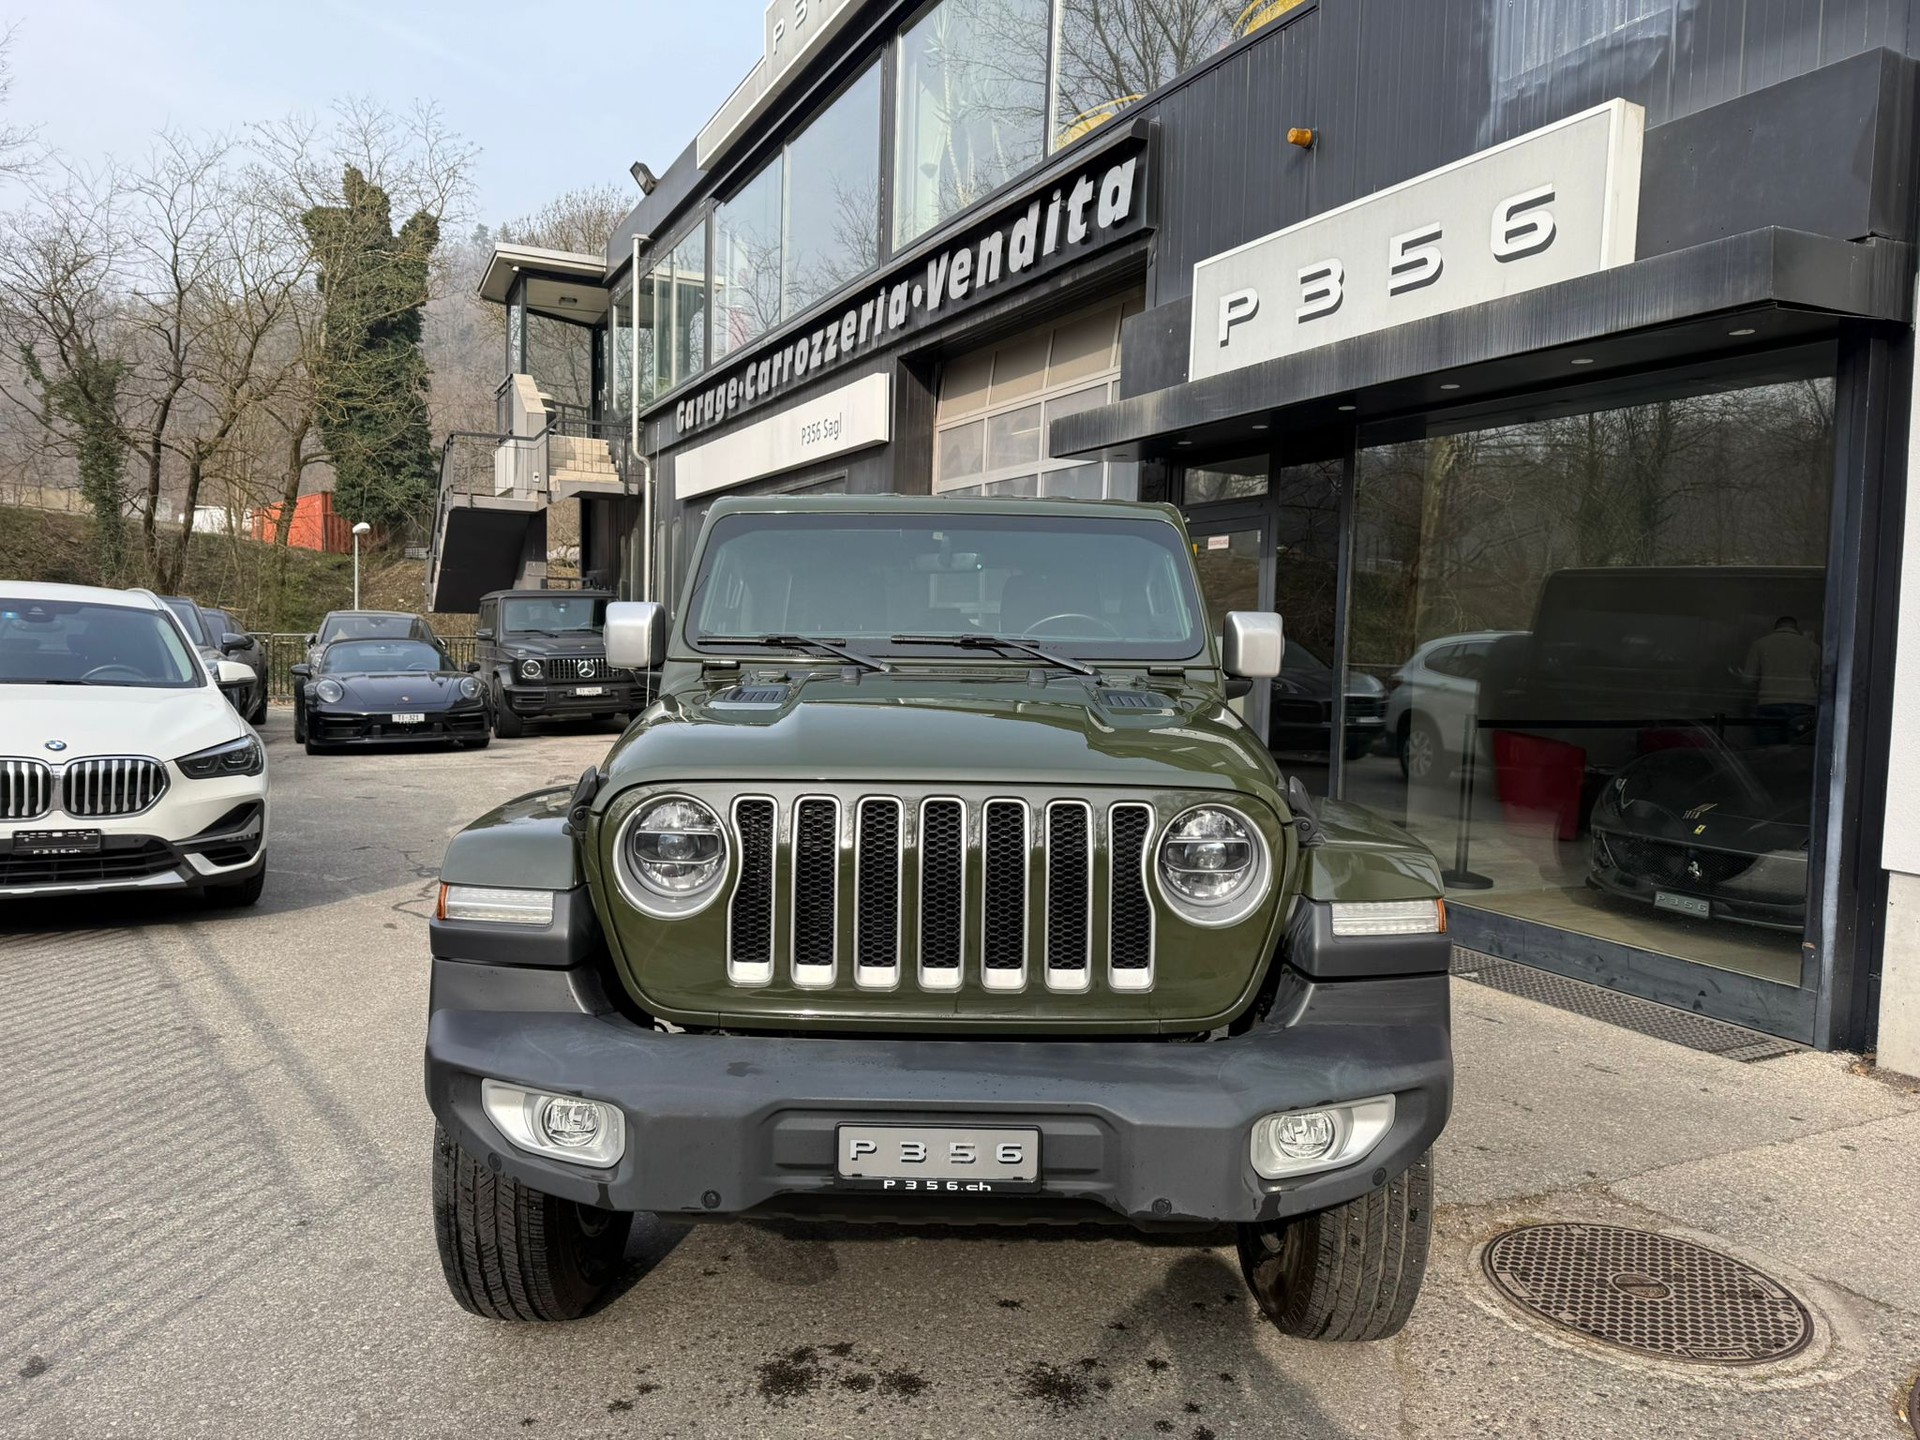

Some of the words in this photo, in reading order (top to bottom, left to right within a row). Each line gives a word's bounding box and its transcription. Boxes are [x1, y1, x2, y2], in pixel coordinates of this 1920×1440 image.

[773, 0, 821, 55] P3
[676, 377, 738, 433] Garage
[745, 280, 909, 400] Carrozzeria
[926, 157, 1137, 312] Vendita
[801, 420, 822, 446] P356
[823, 412, 842, 441] Sagl
